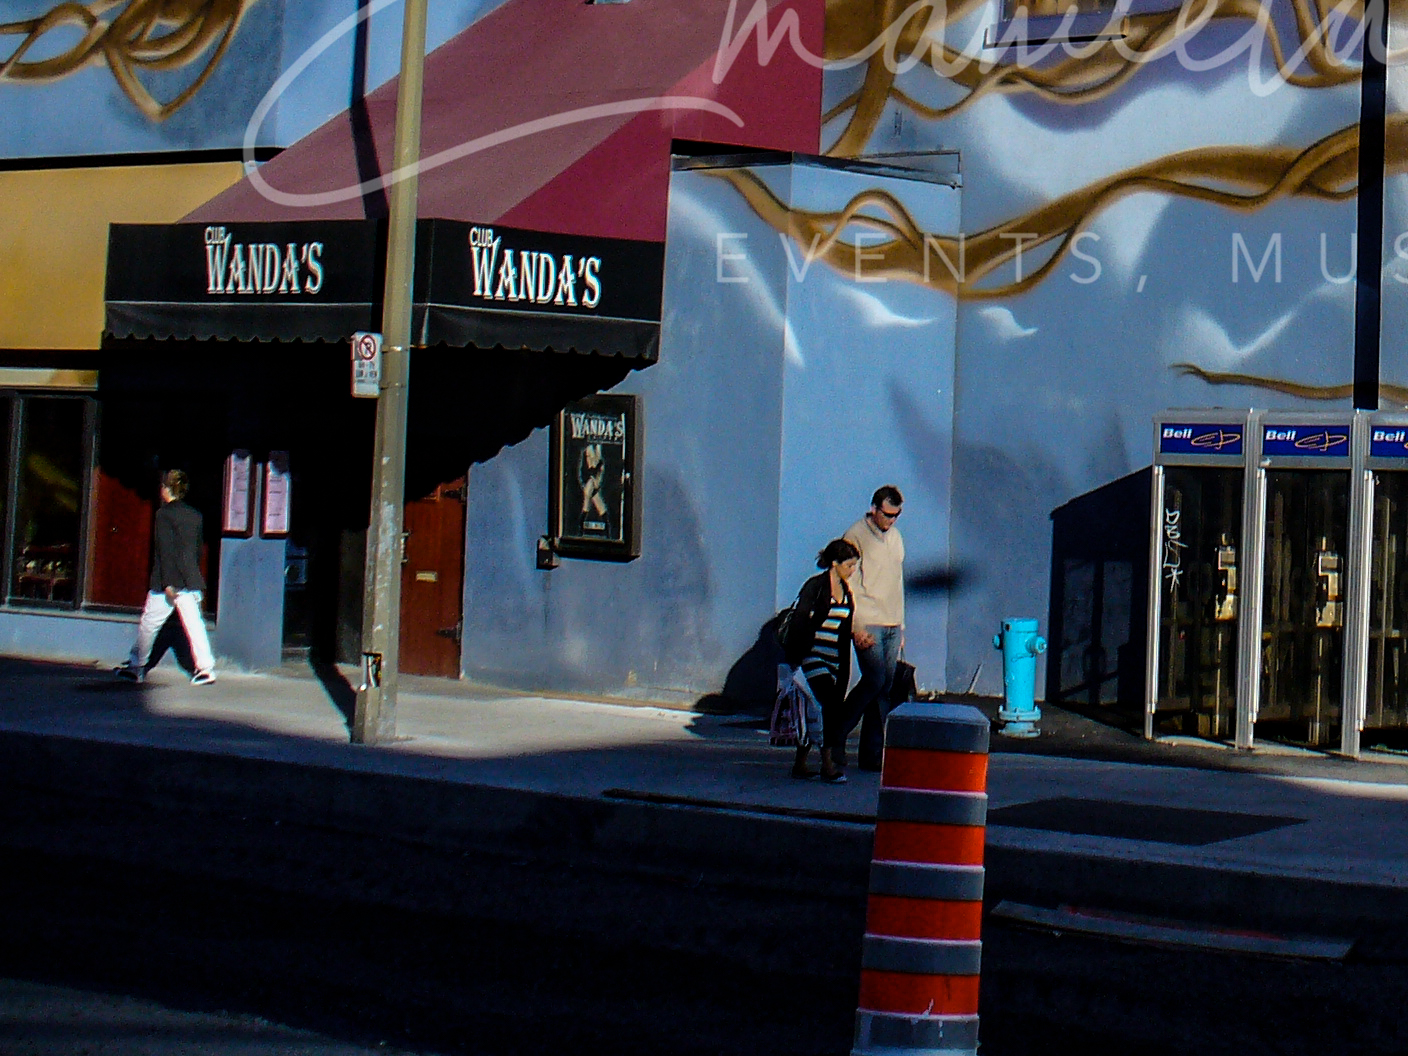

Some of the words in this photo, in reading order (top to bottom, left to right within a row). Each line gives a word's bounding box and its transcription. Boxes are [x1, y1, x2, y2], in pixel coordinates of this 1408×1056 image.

[205, 226, 227, 244] CLUB
[469, 226, 494, 247] CLUB
[205, 232, 324, 295] WANDA'S
[471, 235, 602, 309] WANDA'S
[1162, 428, 1193, 440] Bell
[1265, 429, 1297, 441] Bell
[1373, 430, 1406, 443] Bell
